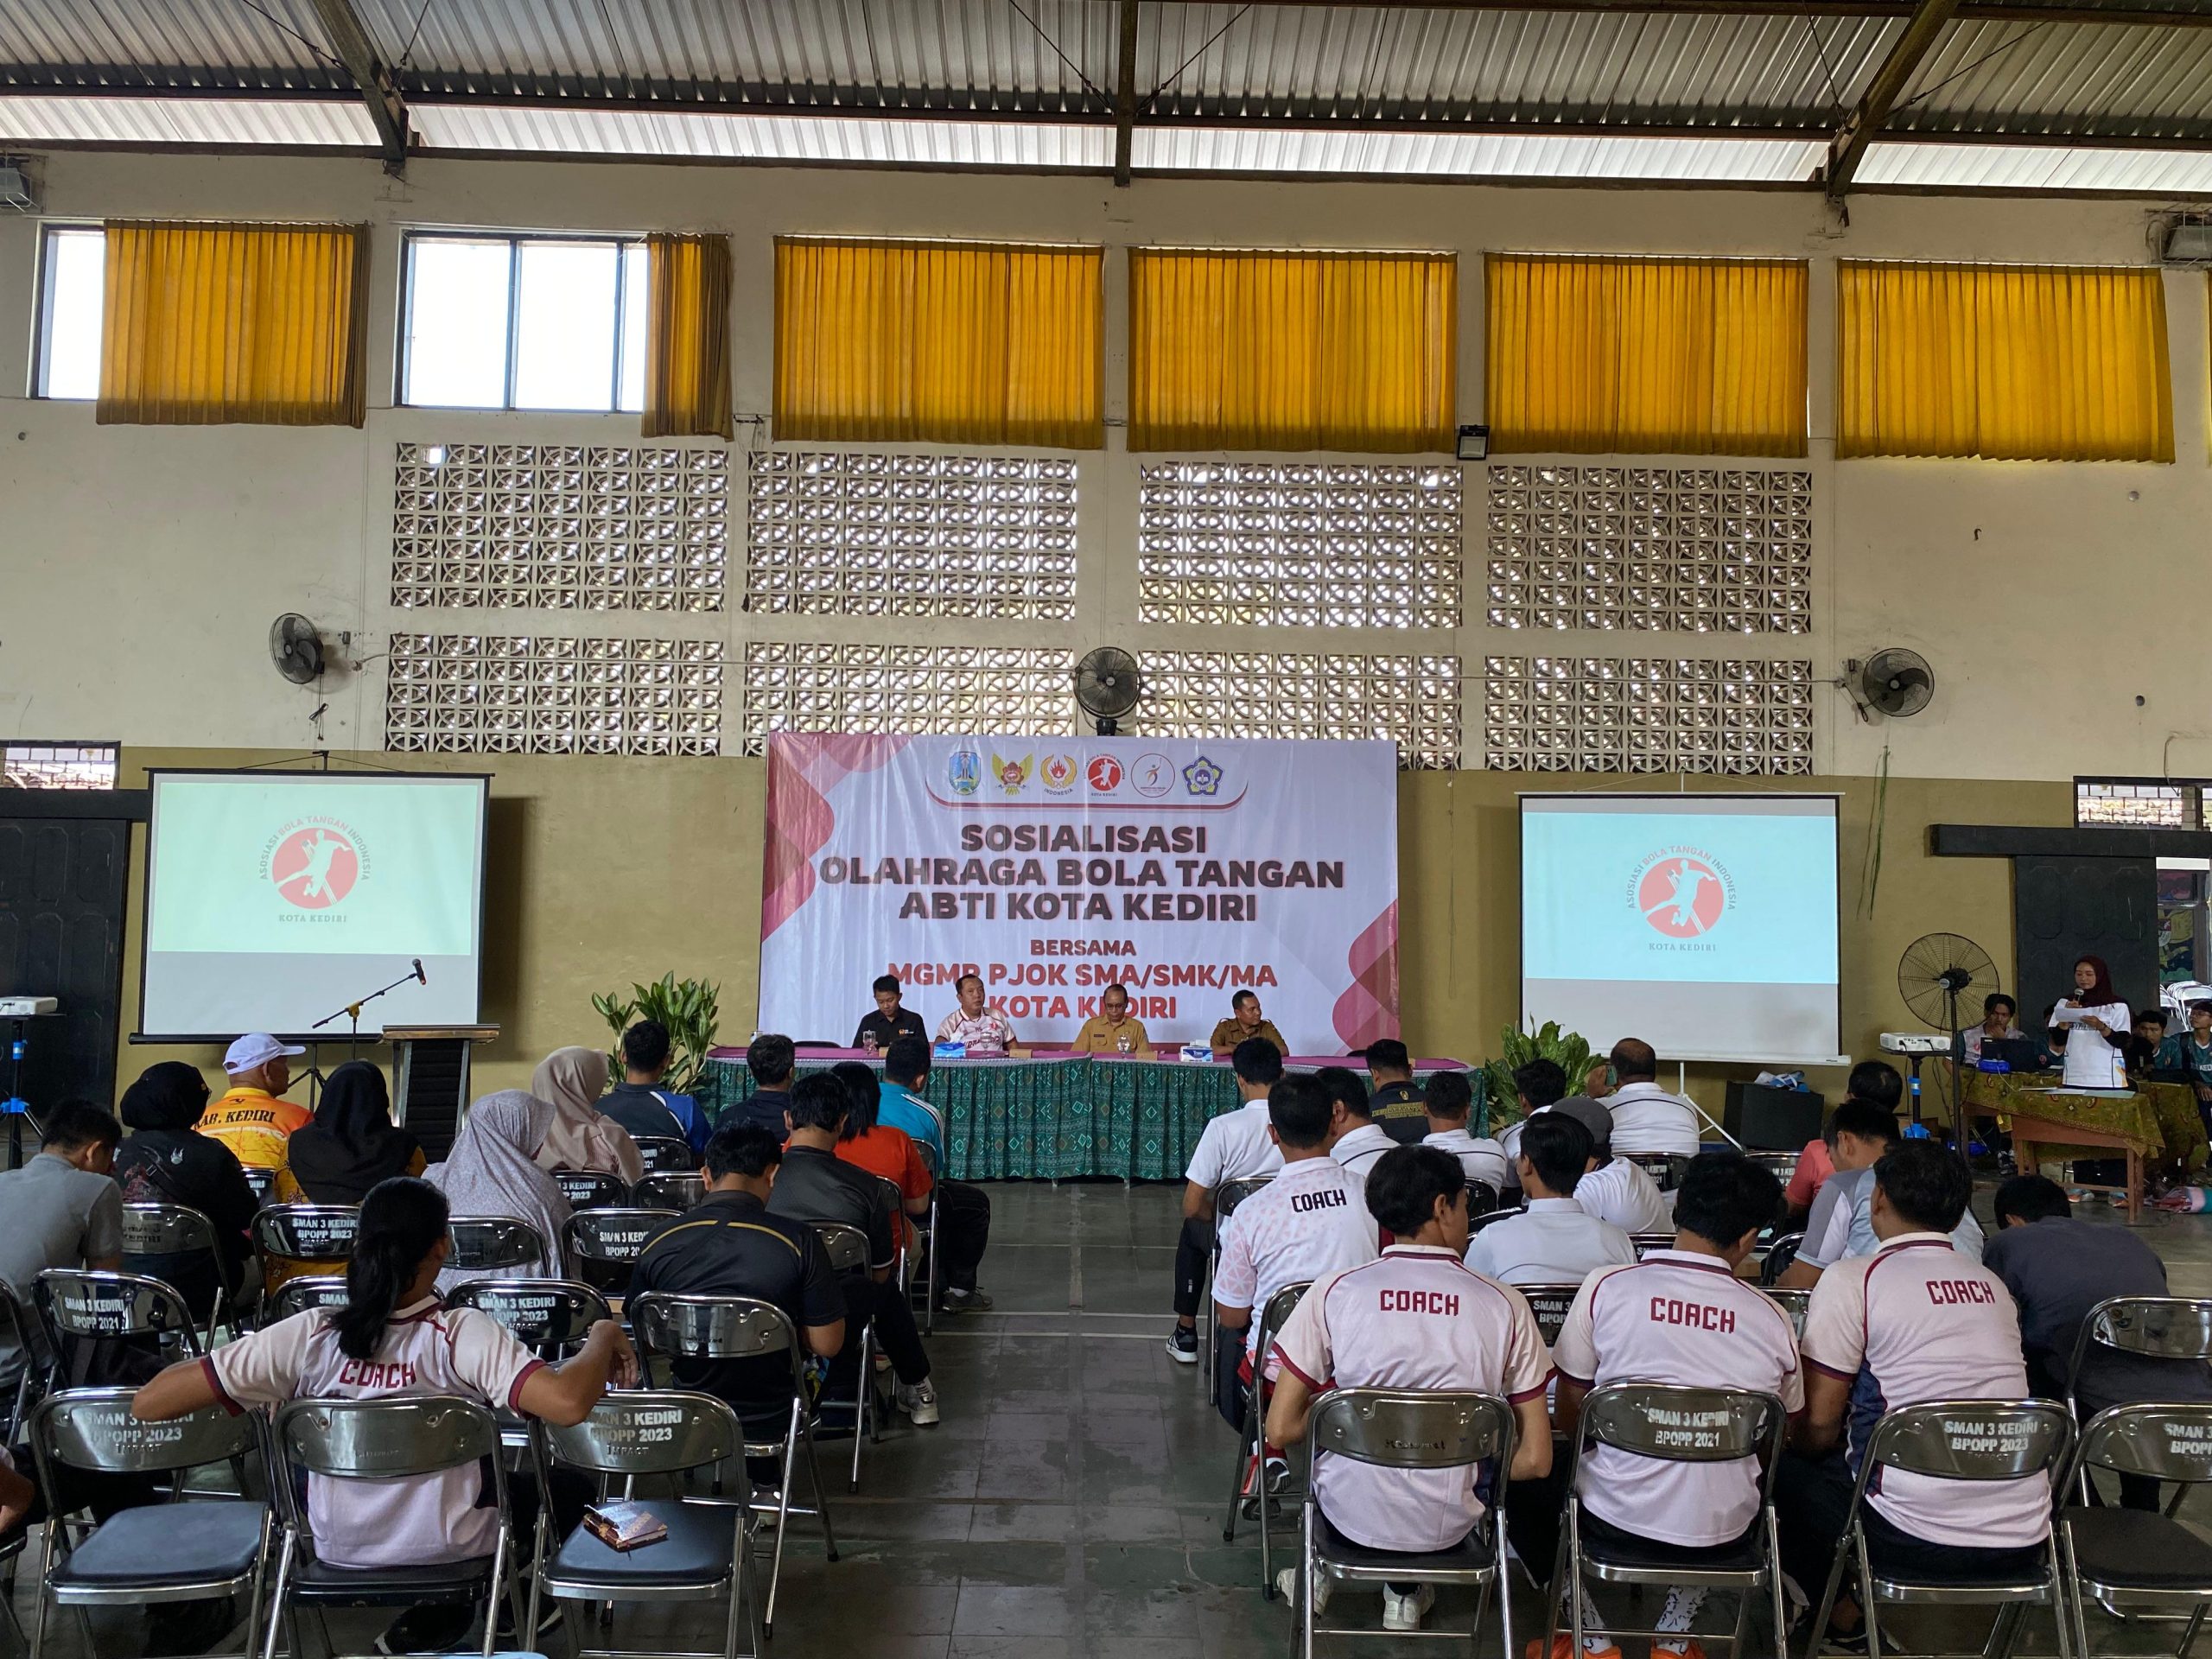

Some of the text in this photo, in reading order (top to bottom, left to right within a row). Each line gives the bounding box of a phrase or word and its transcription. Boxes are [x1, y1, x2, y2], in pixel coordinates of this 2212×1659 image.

[961, 824, 1205, 853] SOSIALISASI
[259, 816, 371, 880] ASOSIASI BOLA TANGAN INDONESIA
[819, 857, 1344, 888] OLAHRAGA BOLA TANGAN
[1626, 846, 1737, 910] ASOSIASI BOLA TANGAN INDONESIA
[899, 893, 1255, 921] ABTI KOTA KEDIRI
[1030, 939, 1136, 956] BERSAMA
[989, 963, 1068, 986] PJOK
[1075, 964, 1277, 989] SMA/SMK/MA
[989, 995, 1070, 1018] KOTA
[225, 1109, 276, 1123] KEDIRI
[569, 1181, 596, 1190] KEDIRI
[1291, 1189, 1347, 1212] COACH
[292, 1218, 318, 1228] SMAN
[297, 1230, 328, 1238] BPOPP
[622, 1232, 626, 1243] 3
[605, 1247, 629, 1256] BPOPP
[1926, 1280, 1995, 1305] COACH
[65, 1297, 124, 1312] SMAN 3 KEDIRI
[479, 1297, 556, 1309] SMAN 3 KEDIRI
[1380, 1290, 1459, 1316] COACH
[1533, 1300, 1571, 1312] SMAN 3
[72, 1315, 118, 1330] BPOPP 2021
[523, 1310, 549, 1322] 2023
[1650, 1297, 1735, 1333] COACH
[339, 1358, 416, 1389] COACH
[86, 1412, 124, 1426] SMAN
[623, 1413, 631, 1425] 3
[634, 1409, 682, 1425] KEDIRI
[1648, 1408, 1680, 1426] SMAN
[1683, 1412, 1691, 1426] 3
[146, 1427, 182, 1442] 2023
[639, 1427, 672, 1441] 2023
[1944, 1421, 2038, 1435] SMAN 3 KEDIRI
[2164, 1423, 2203, 1438] SMAN
[1656, 1430, 1719, 1447] BPOPP 2021
[1952, 1437, 2029, 1452] BPOPP 2023
